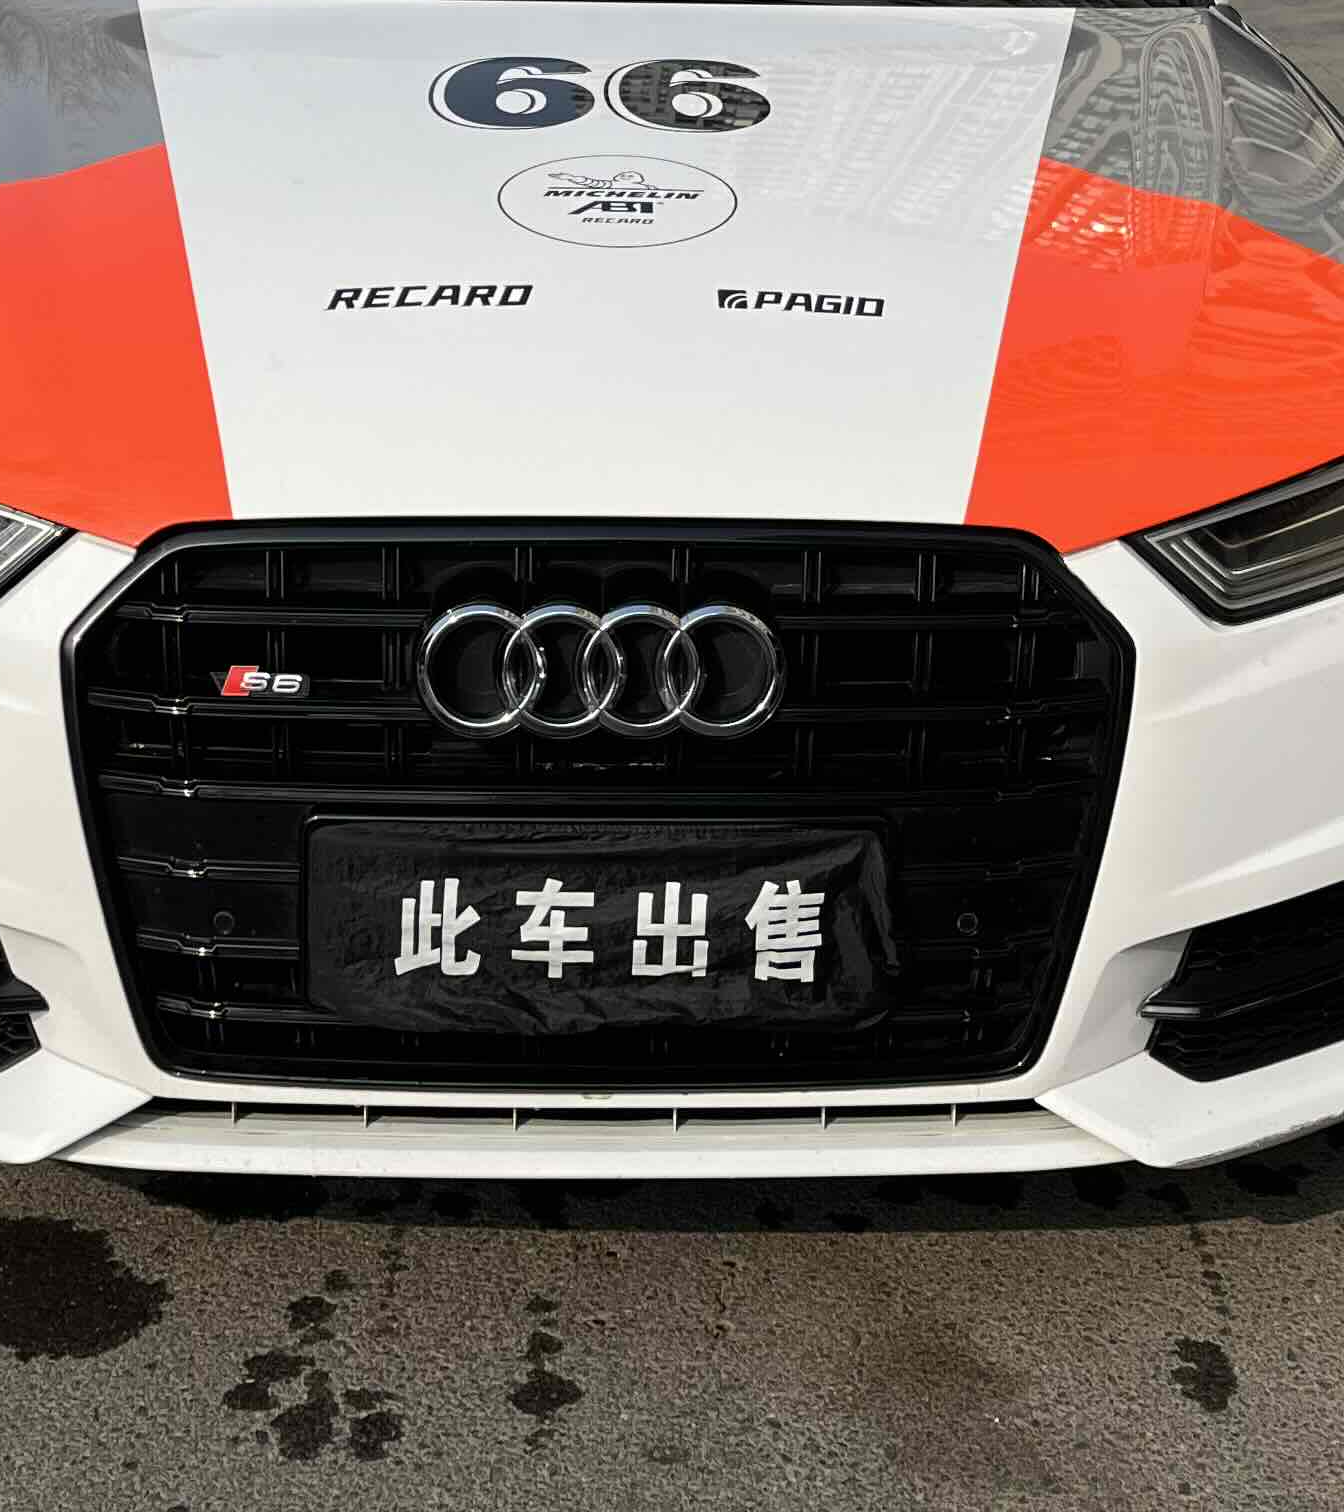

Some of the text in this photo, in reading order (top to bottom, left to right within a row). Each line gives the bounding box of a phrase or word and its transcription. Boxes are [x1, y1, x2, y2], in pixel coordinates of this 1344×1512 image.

[429, 56, 771, 133] 66
[543, 190, 700, 200] MICHELIN
[567, 200, 654, 215] ABT
[581, 217, 655, 225] RECARO
[323, 284, 534, 311] RECARO
[240, 671, 304, 694] S6
[394, 877, 825, 982] 此车出售
